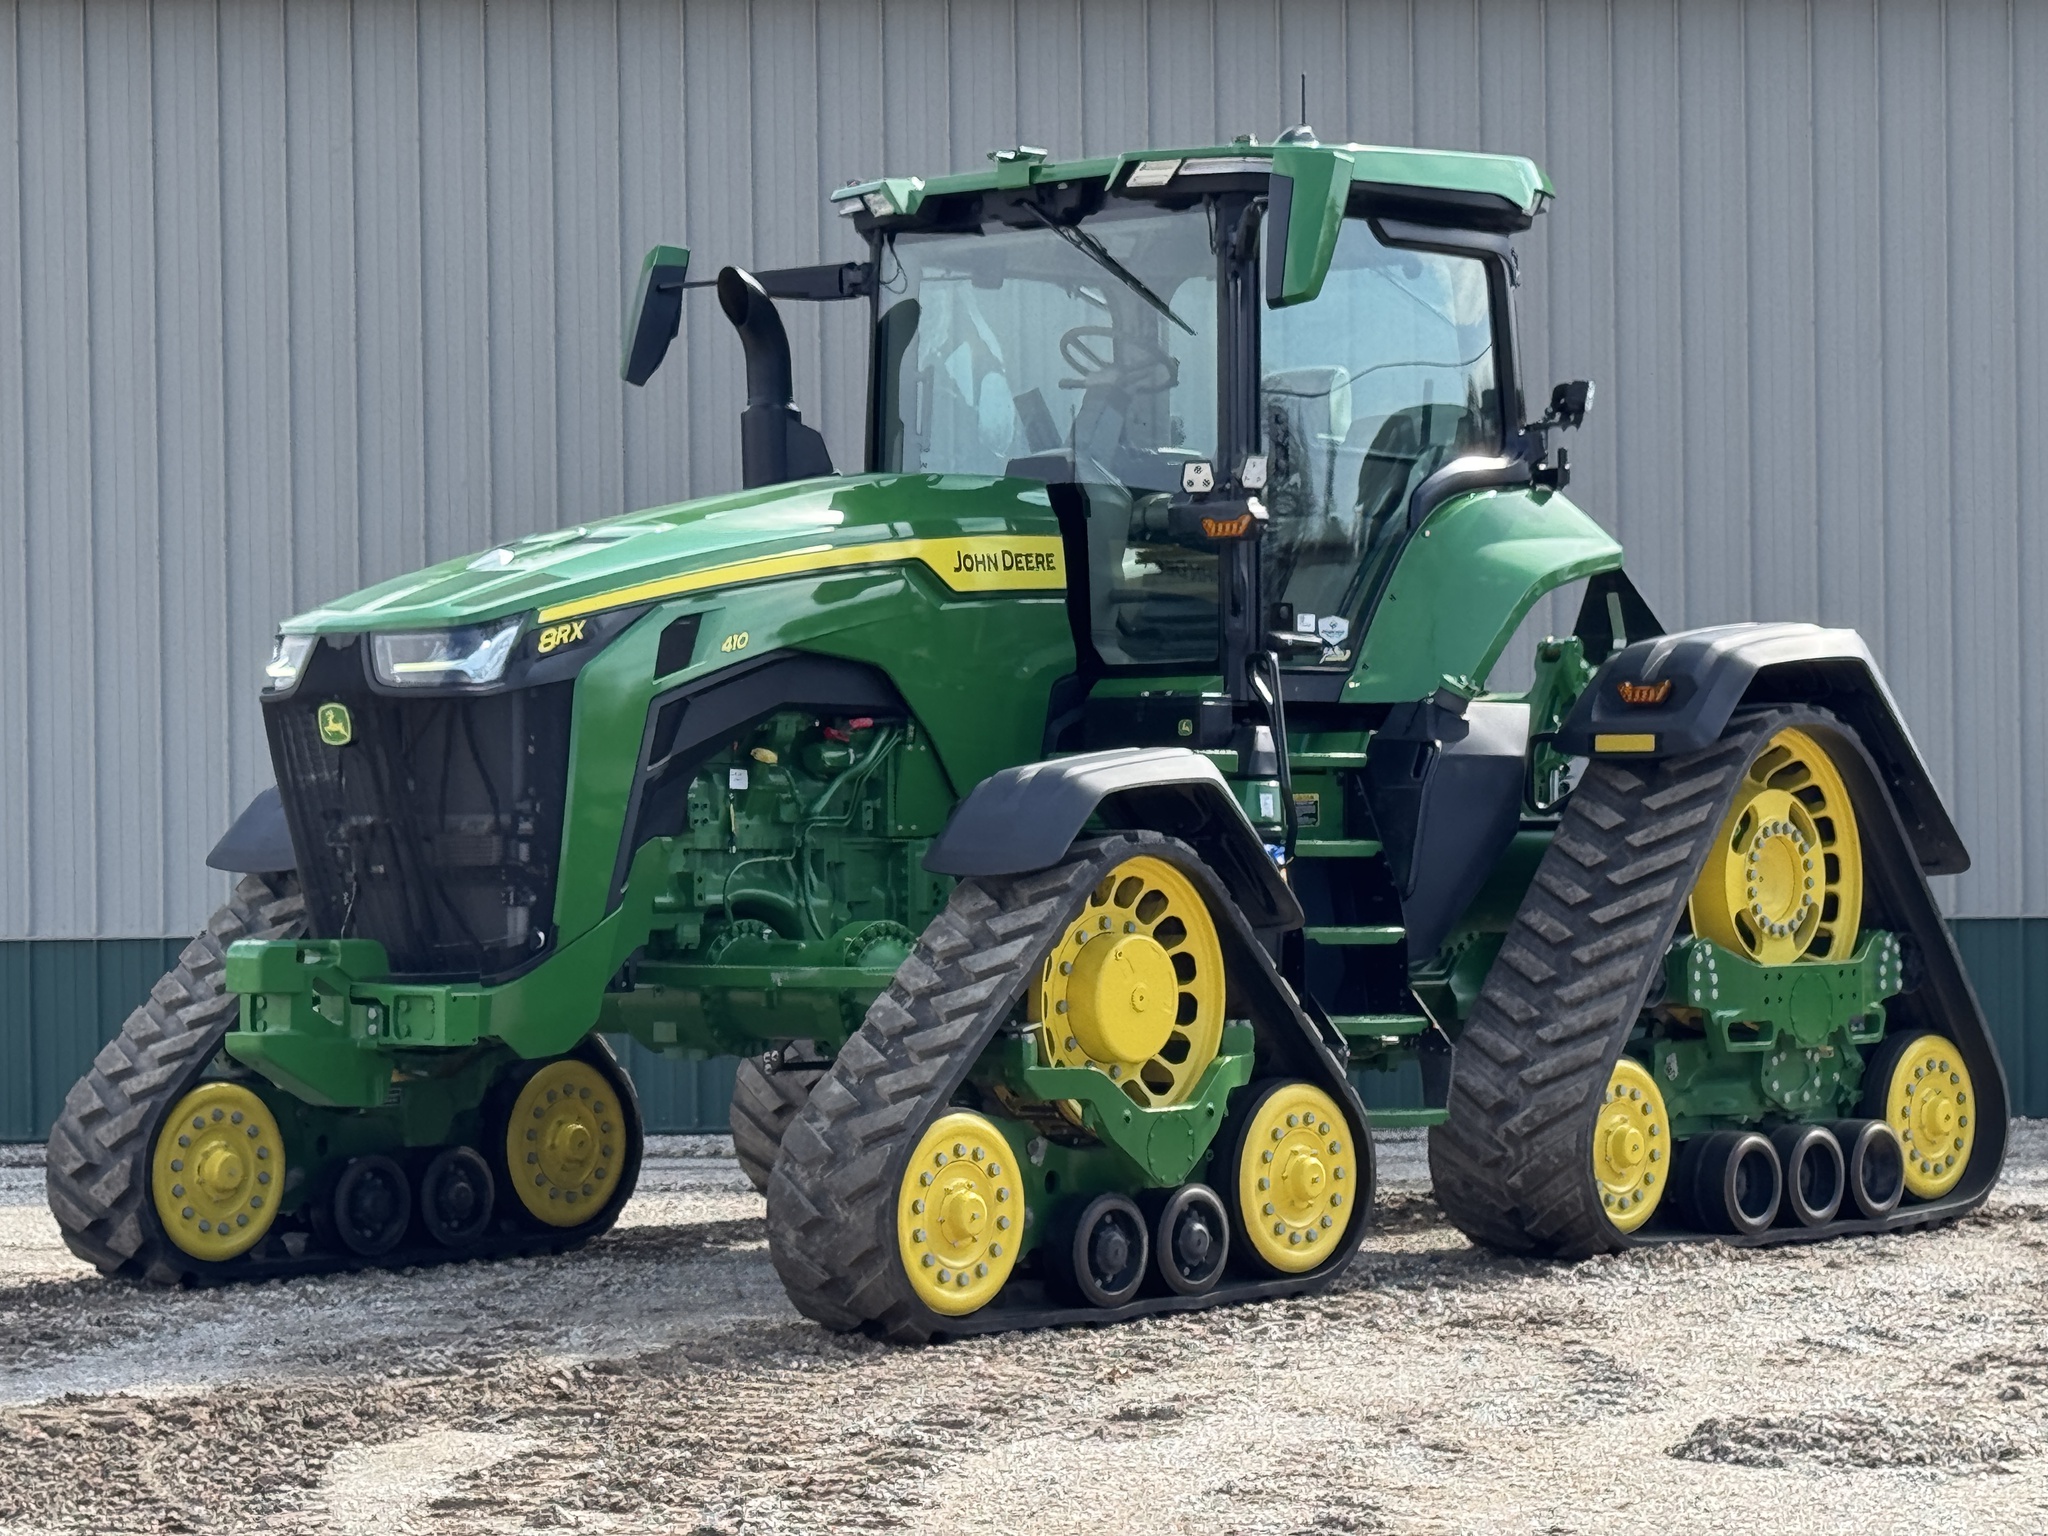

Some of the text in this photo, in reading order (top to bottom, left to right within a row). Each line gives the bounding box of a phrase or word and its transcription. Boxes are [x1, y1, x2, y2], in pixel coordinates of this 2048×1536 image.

[954, 549, 1056, 573] JOHN DEERE
[538, 619, 587, 653] 8RX
[721, 631, 749, 653] 410
